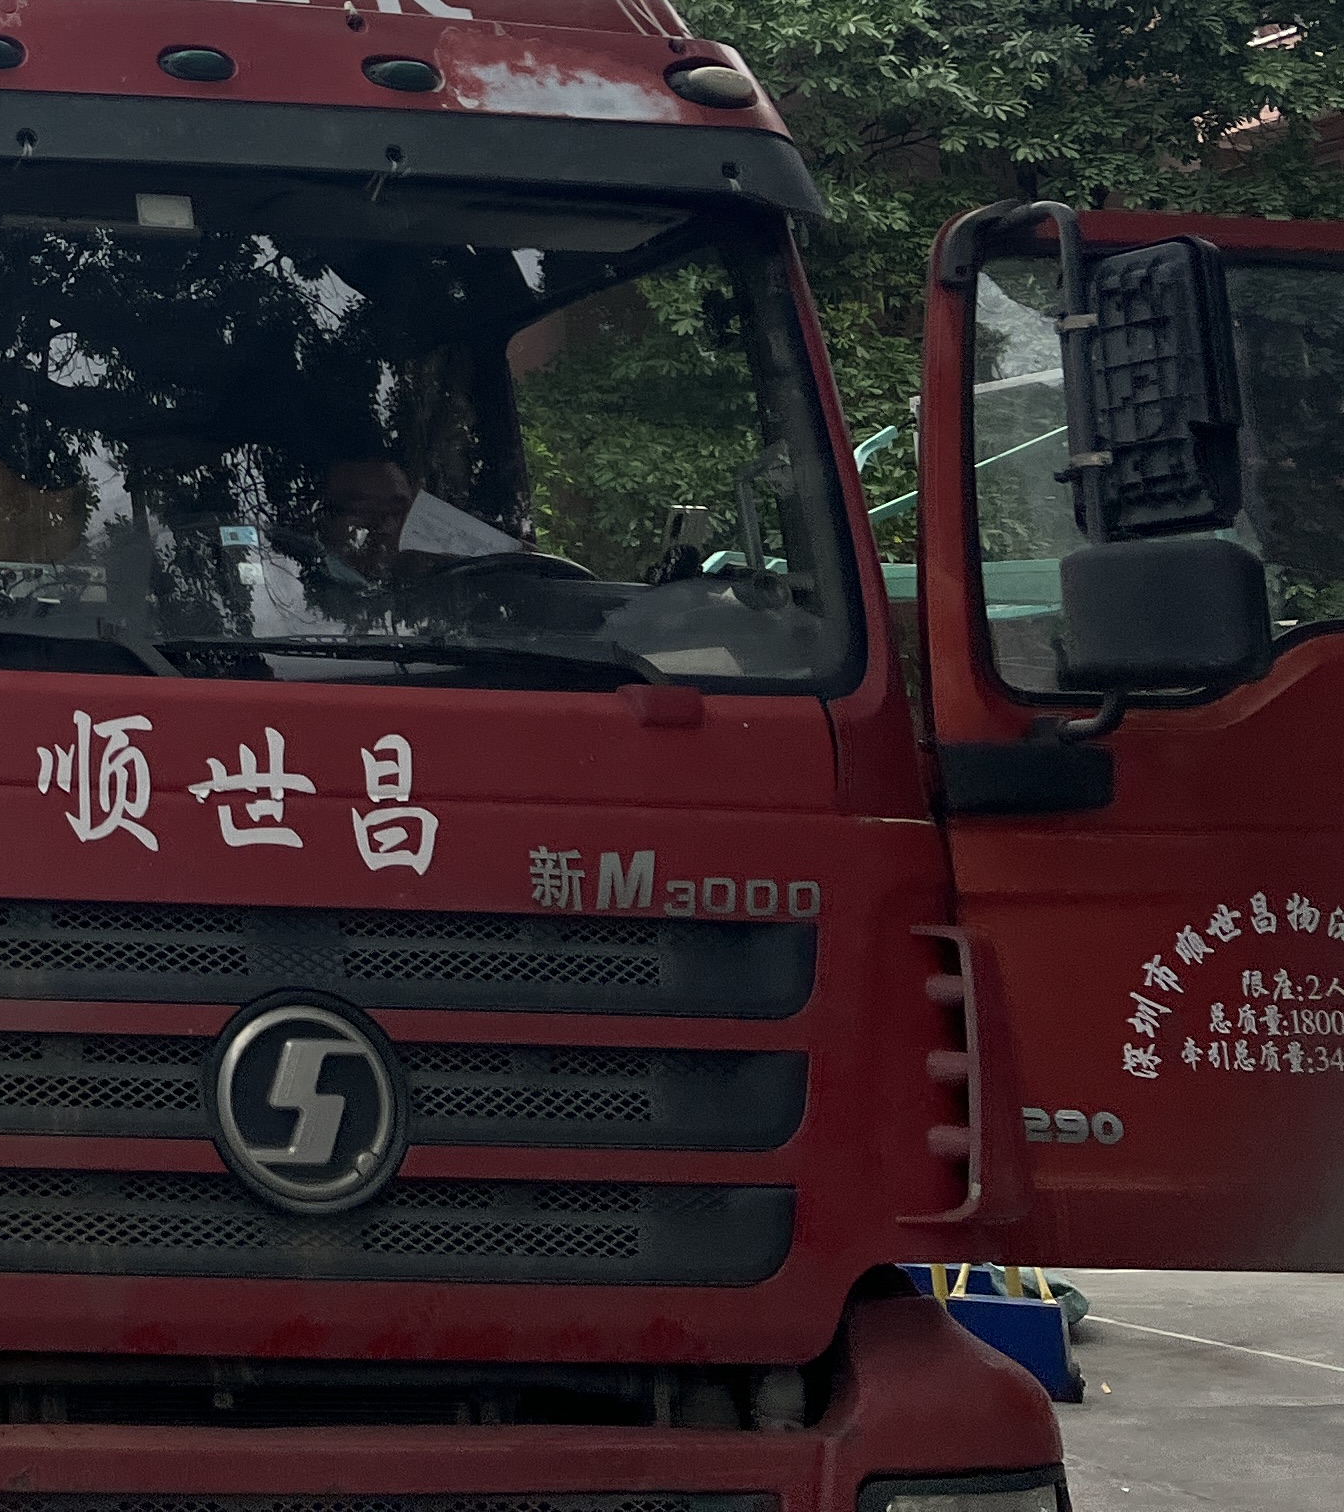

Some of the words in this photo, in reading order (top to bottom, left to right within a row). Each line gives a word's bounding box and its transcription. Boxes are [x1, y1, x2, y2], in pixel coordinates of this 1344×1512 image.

[36, 709, 440, 876] 顺世昌
[1021, 1106, 1125, 1145] 290
